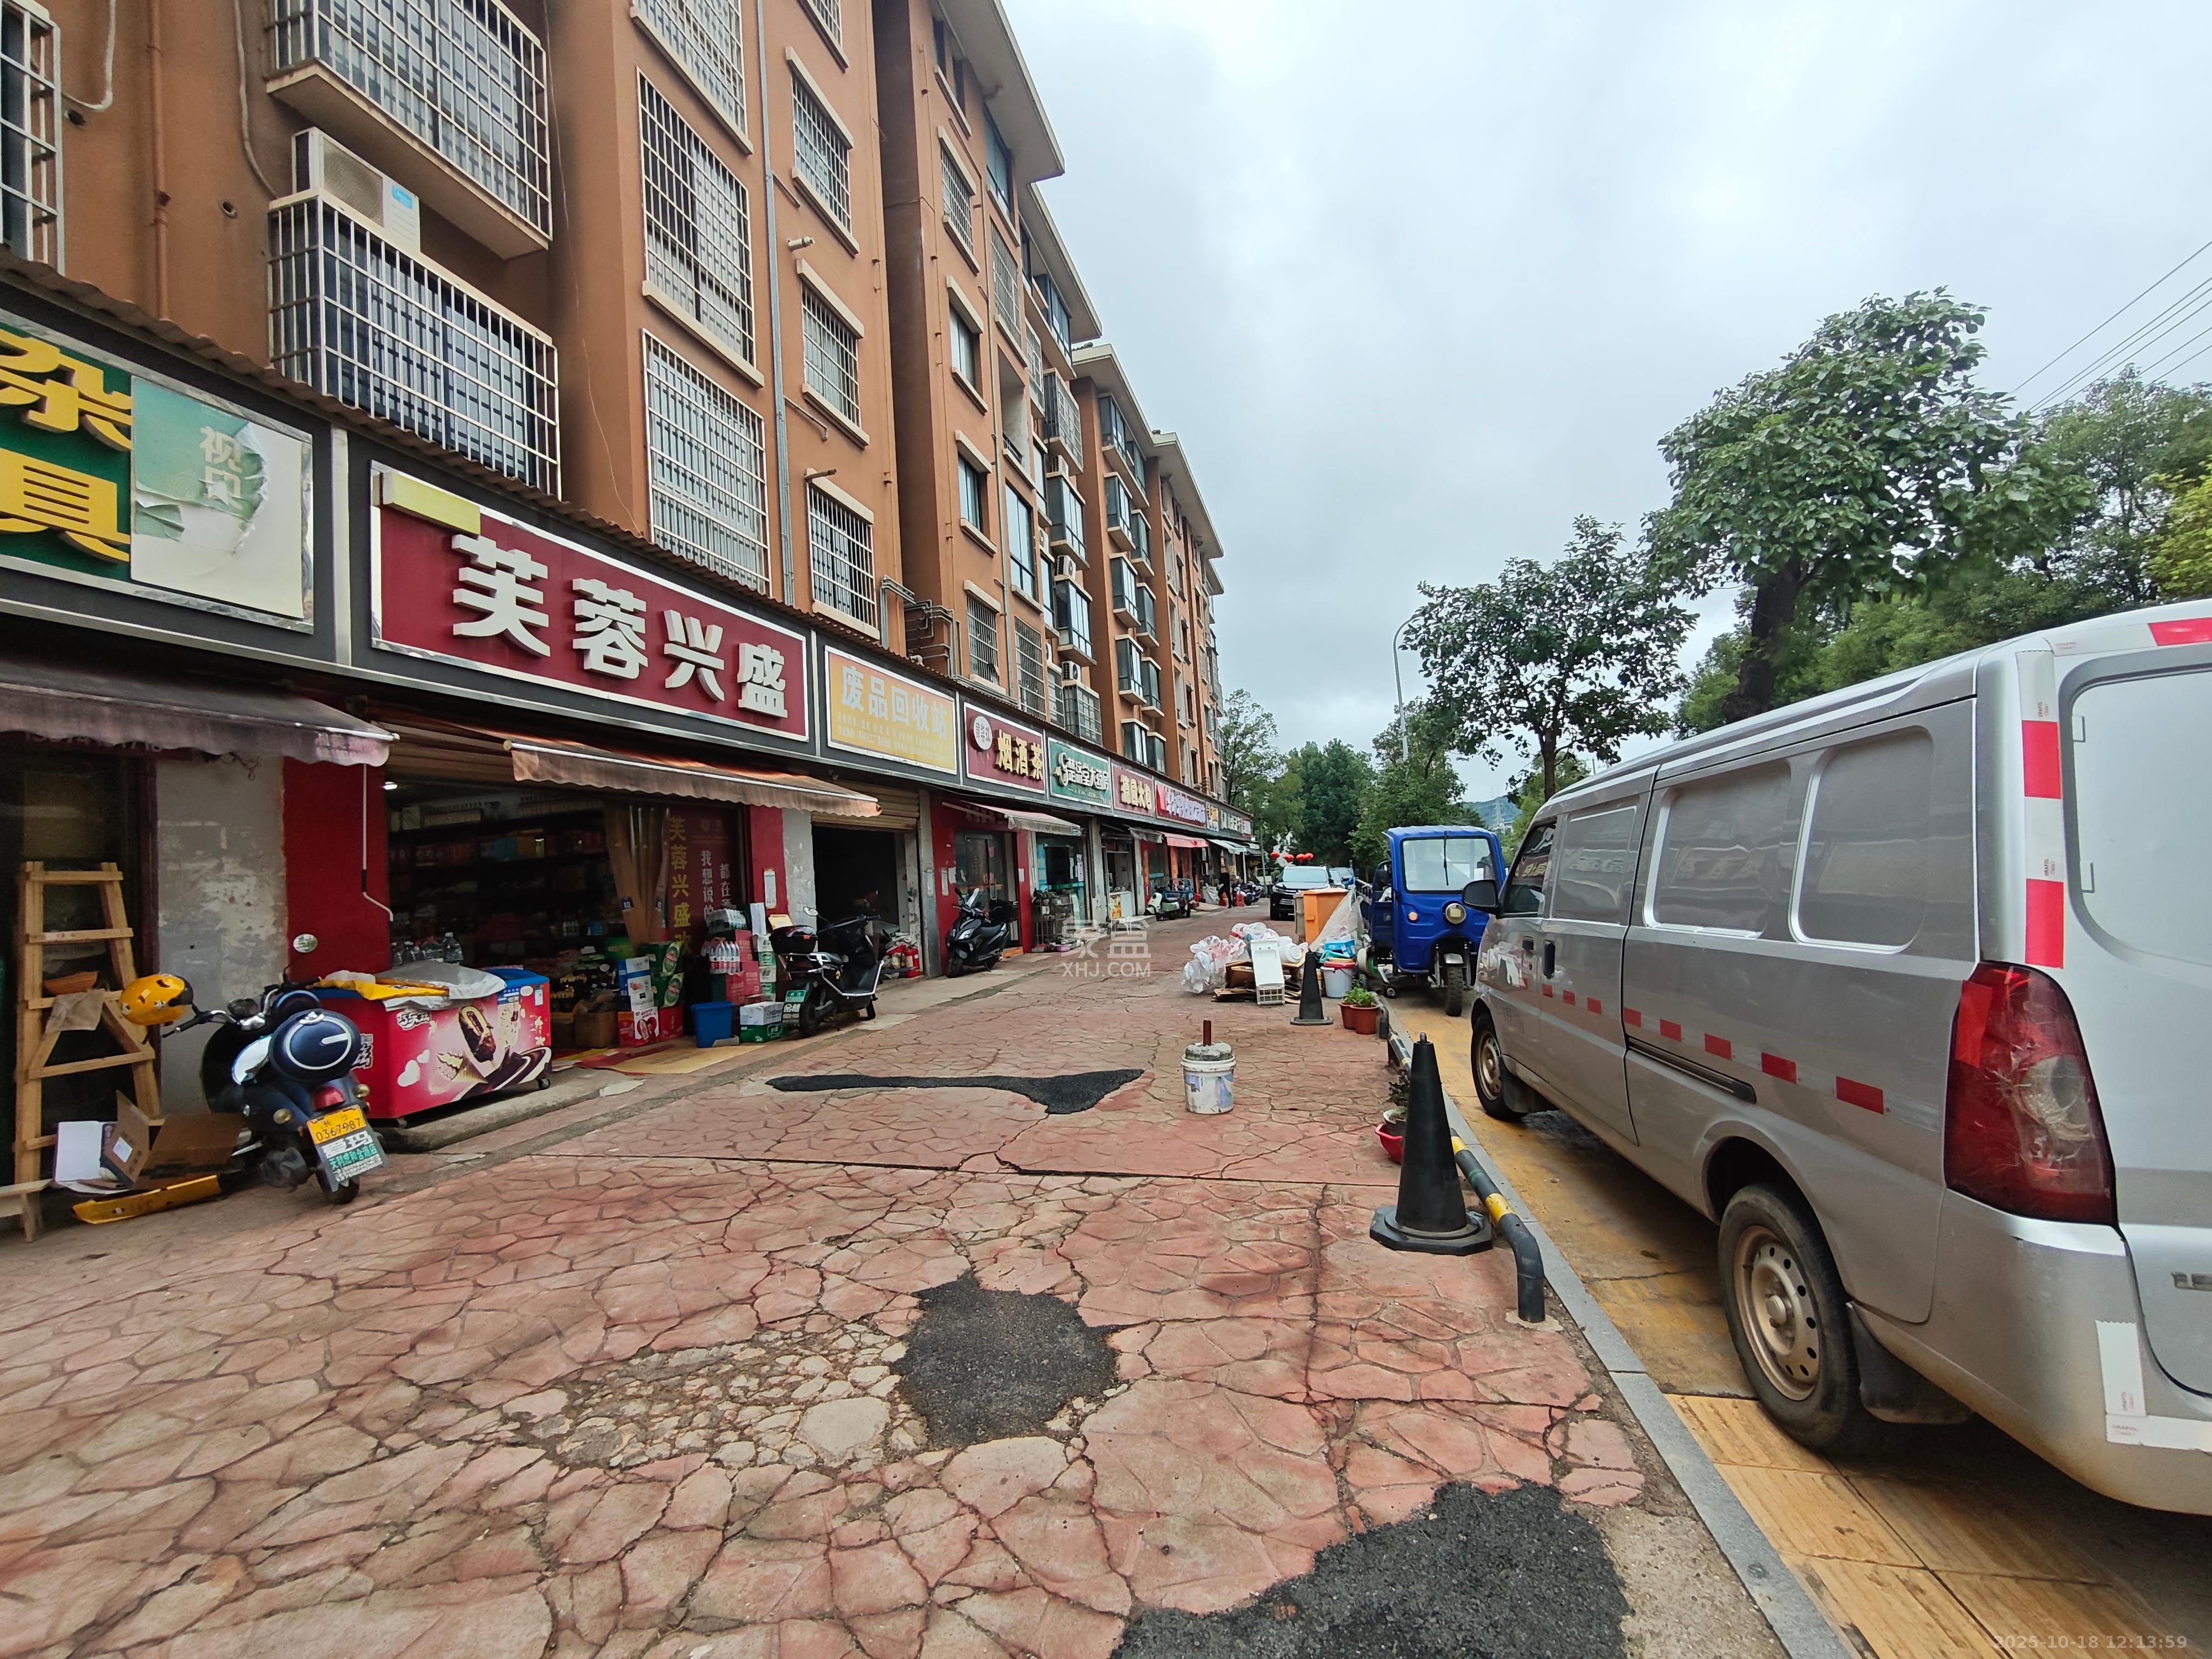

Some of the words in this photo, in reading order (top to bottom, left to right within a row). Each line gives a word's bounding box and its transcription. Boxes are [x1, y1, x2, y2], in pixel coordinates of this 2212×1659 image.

[451, 534, 788, 718] 芙蓉兴盛
[841, 665, 947, 740] 废品回收站
[996, 729, 1043, 780] 烟酒茶
[700, 850, 714, 921] 我想说的
[719, 863, 731, 906] 都在
[315, 1117, 362, 1141] 0367987
